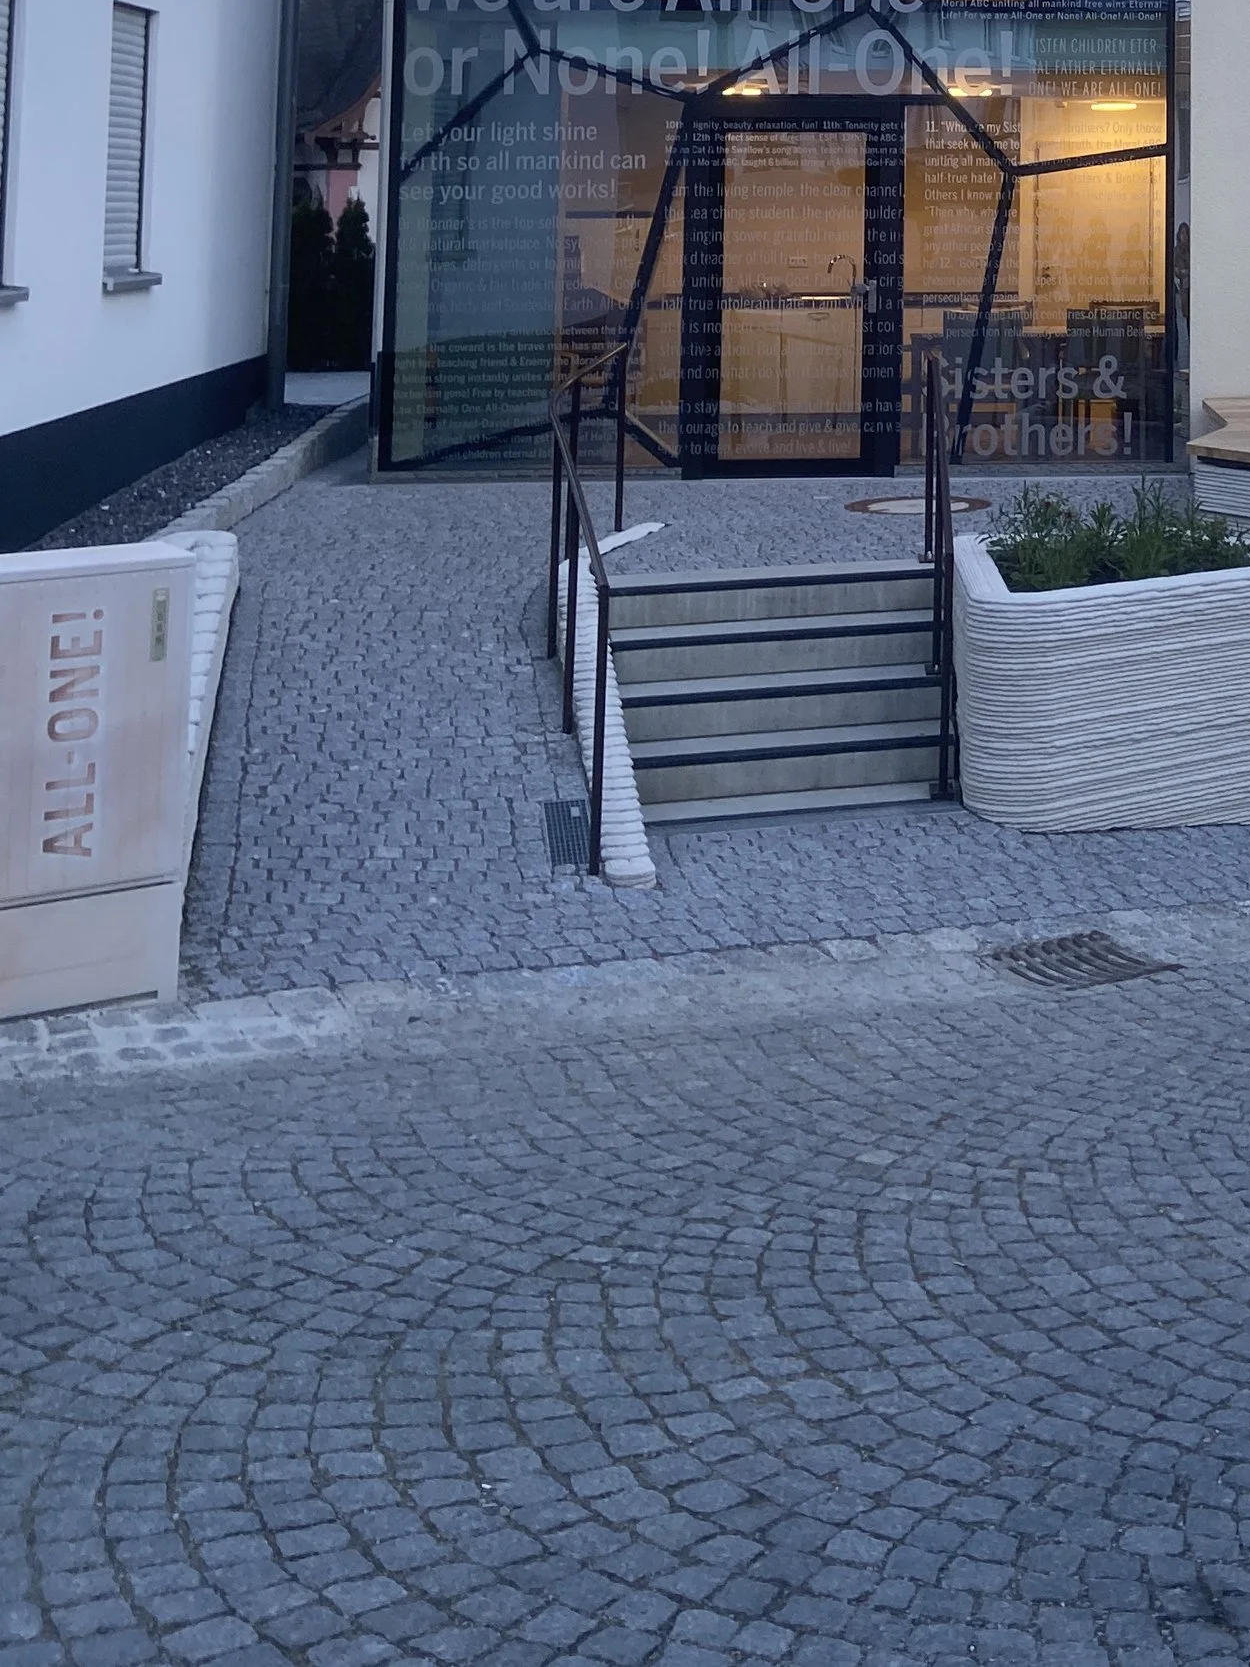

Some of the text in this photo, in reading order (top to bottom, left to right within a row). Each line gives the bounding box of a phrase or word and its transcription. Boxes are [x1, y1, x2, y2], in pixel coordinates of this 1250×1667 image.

[1042, 0, 1081, 8] mankind
[1011, 12, 1121, 20] All-One None! All-One!
[1029, 38, 1160, 54] LISTEN CHILDREN ETER-
[404, 28, 1012, 97] or None! All-One!
[1055, 61, 1161, 76] FATHER ETERNALLY
[1029, 82, 1161, 97] ONE! WE ARE ALL-ONE!
[401, 123, 597, 146] Let your light shine
[925, 138, 968, 149] that seek
[457, 155, 480, 170] so
[487, 151, 509, 170] all
[516, 151, 603, 170] mankind
[610, 154, 646, 170] can
[925, 154, 973, 167] uniting all
[925, 172, 996, 184] half-true hate!
[399, 179, 616, 205] see your good works!
[925, 189, 992, 200] Others know
[1101, 309, 1140, 321] Barbaric
[1093, 354, 1127, 399] &
[42, 608, 104, 857] ALL-ONE!
